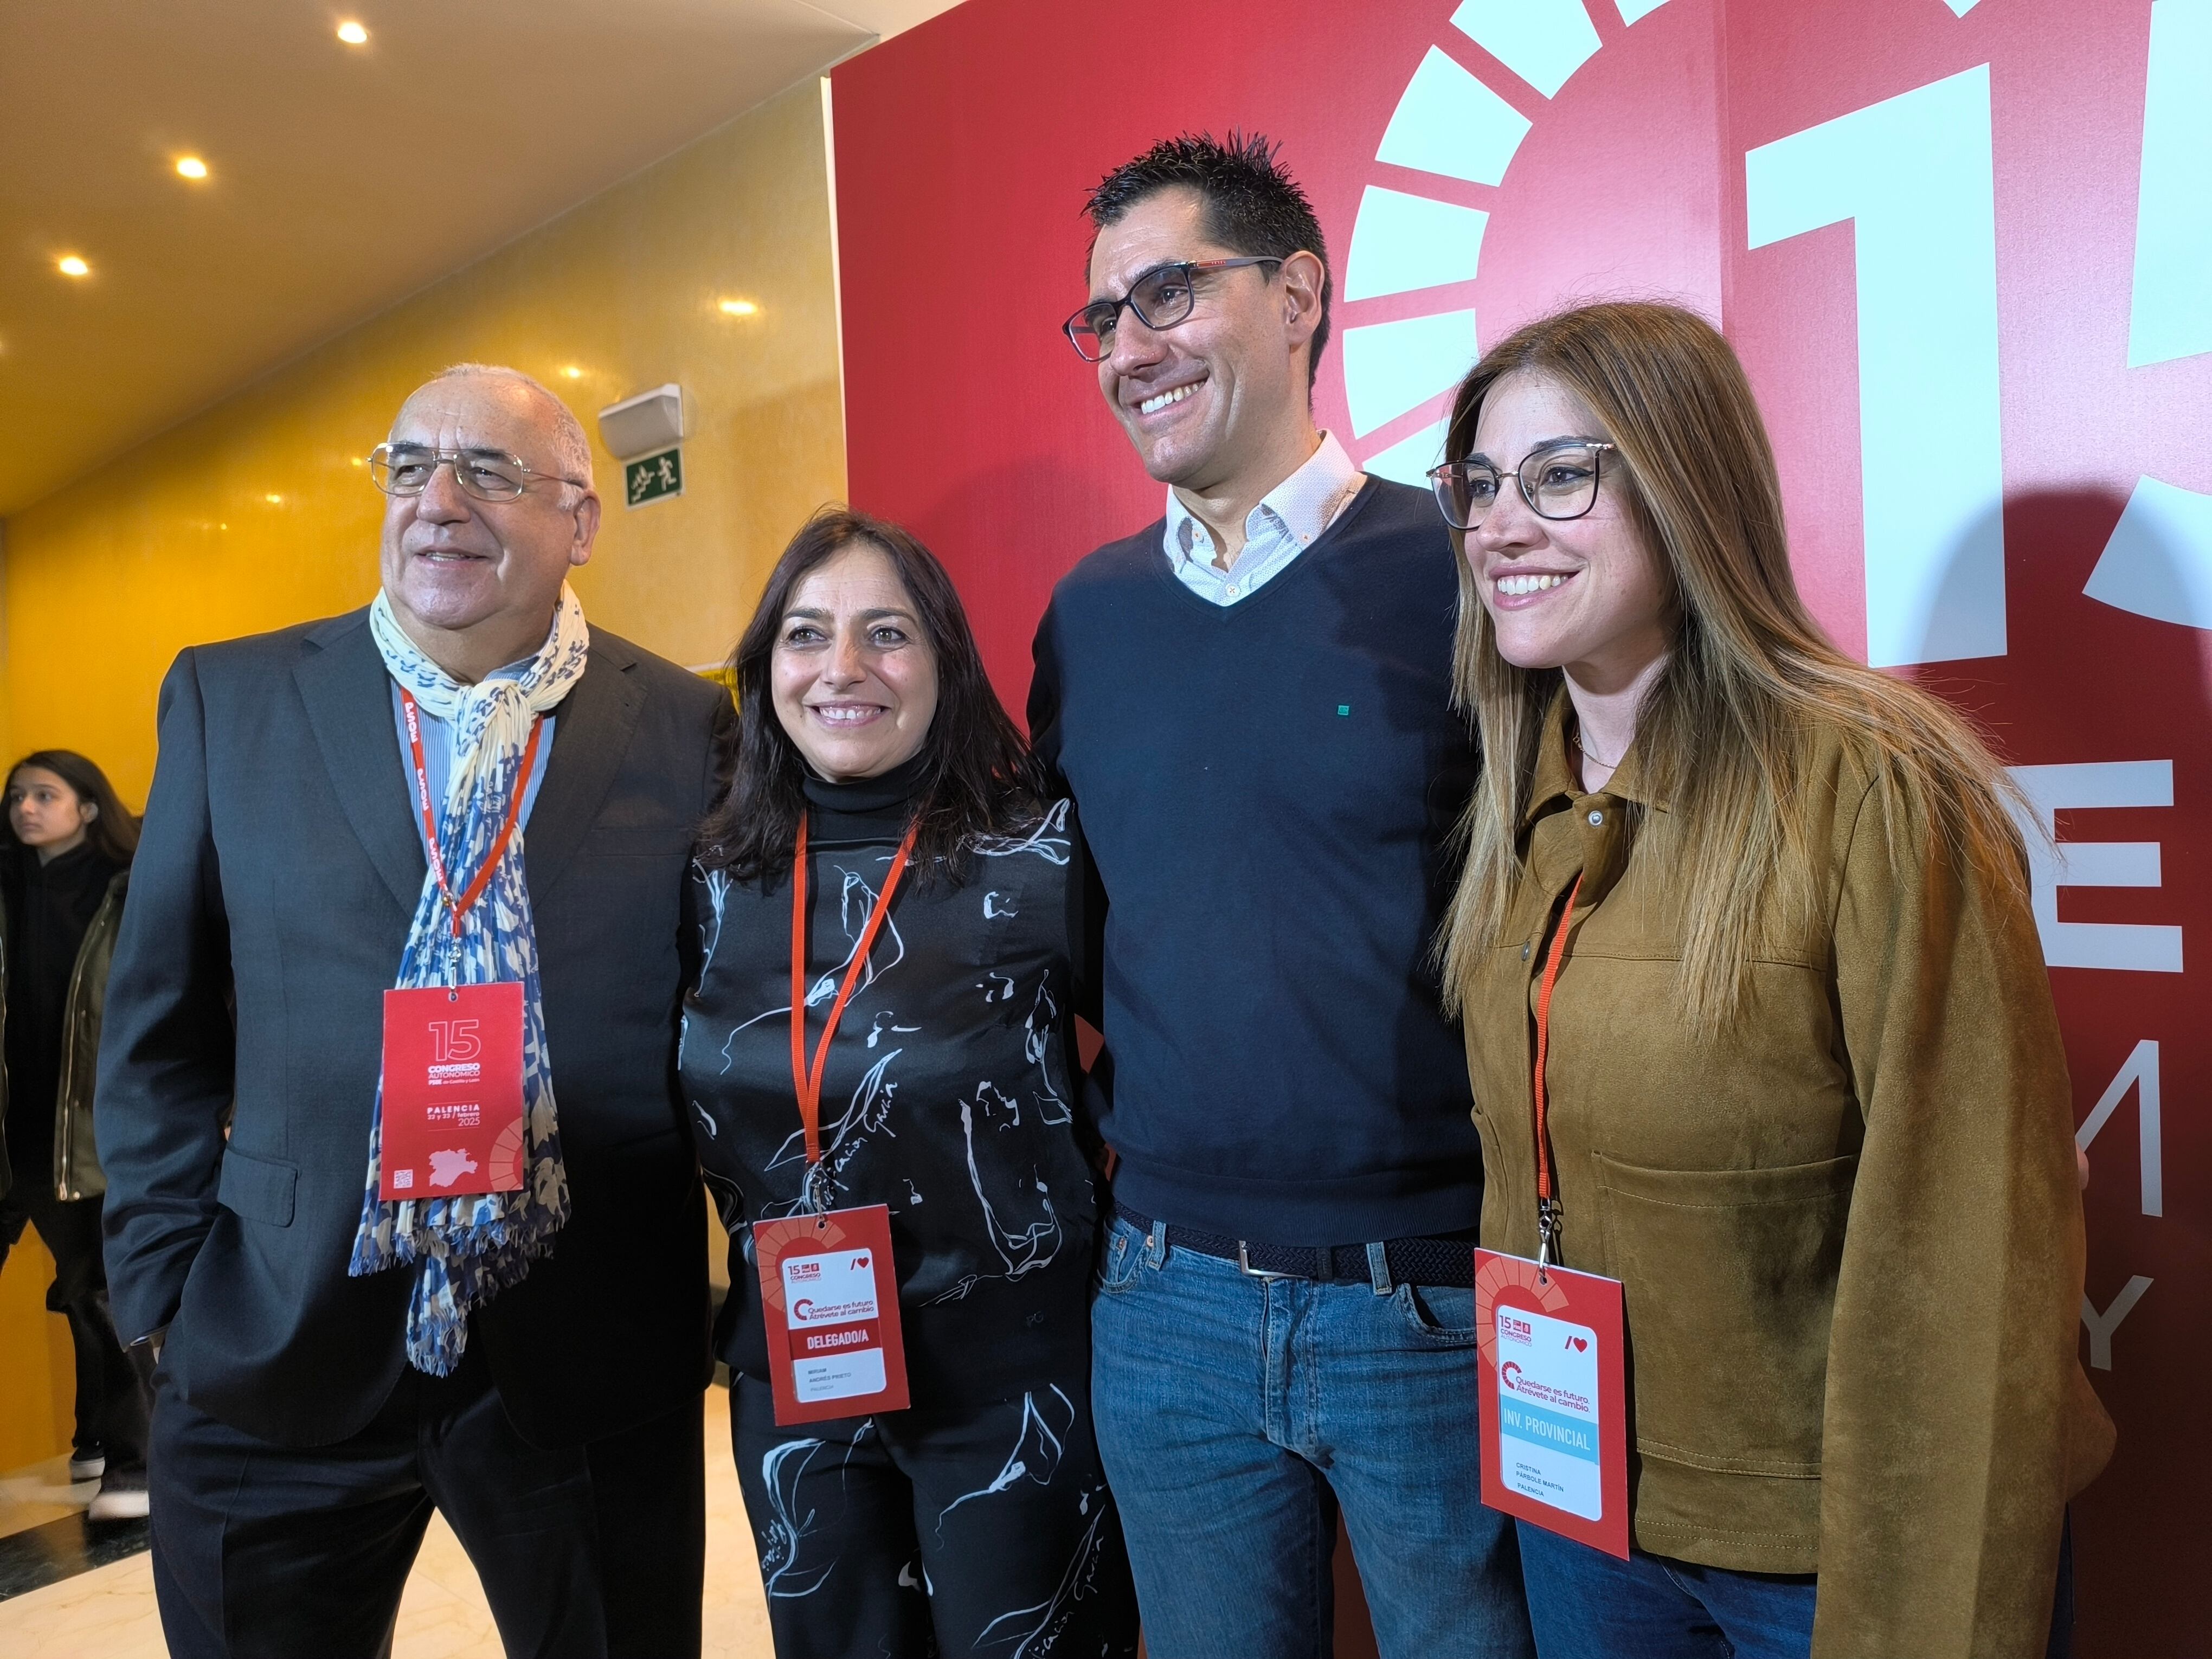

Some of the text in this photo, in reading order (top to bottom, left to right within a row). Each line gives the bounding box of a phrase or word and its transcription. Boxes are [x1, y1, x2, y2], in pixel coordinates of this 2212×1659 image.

[405, 702, 418, 743] PSOE
[417, 768, 429, 812] PSOE
[429, 837, 443, 882] PSOE
[429, 1019, 481, 1062] 15
[428, 1063, 480, 1073] CONGRESO
[427, 1104, 480, 1114] PALENCIA
[458, 1117, 480, 1127] 2025
[788, 1265, 800, 1275] 15
[790, 1272, 821, 1281] CONGRESO
[808, 1306, 841, 1314] Quedarse
[1500, 1315, 1511, 1329] 15
[807, 1329, 869, 1350] DELEGADO/A
[1501, 1328, 1532, 1342] CONGRESO
[1516, 1377, 1552, 1393] Quedarse
[1564, 1390, 1590, 1404] futuro.
[1516, 1385, 1548, 1400] Atrévete
[1558, 1399, 1590, 1413] cambio.
[1504, 1408, 1591, 1451] INV. PROVINCIAL
[1516, 1462, 1541, 1475] CRISTINA
[1516, 1471, 1564, 1492] PÁRBOLE MARTÍN
[1517, 1483, 1545, 1496] PALENCIA
